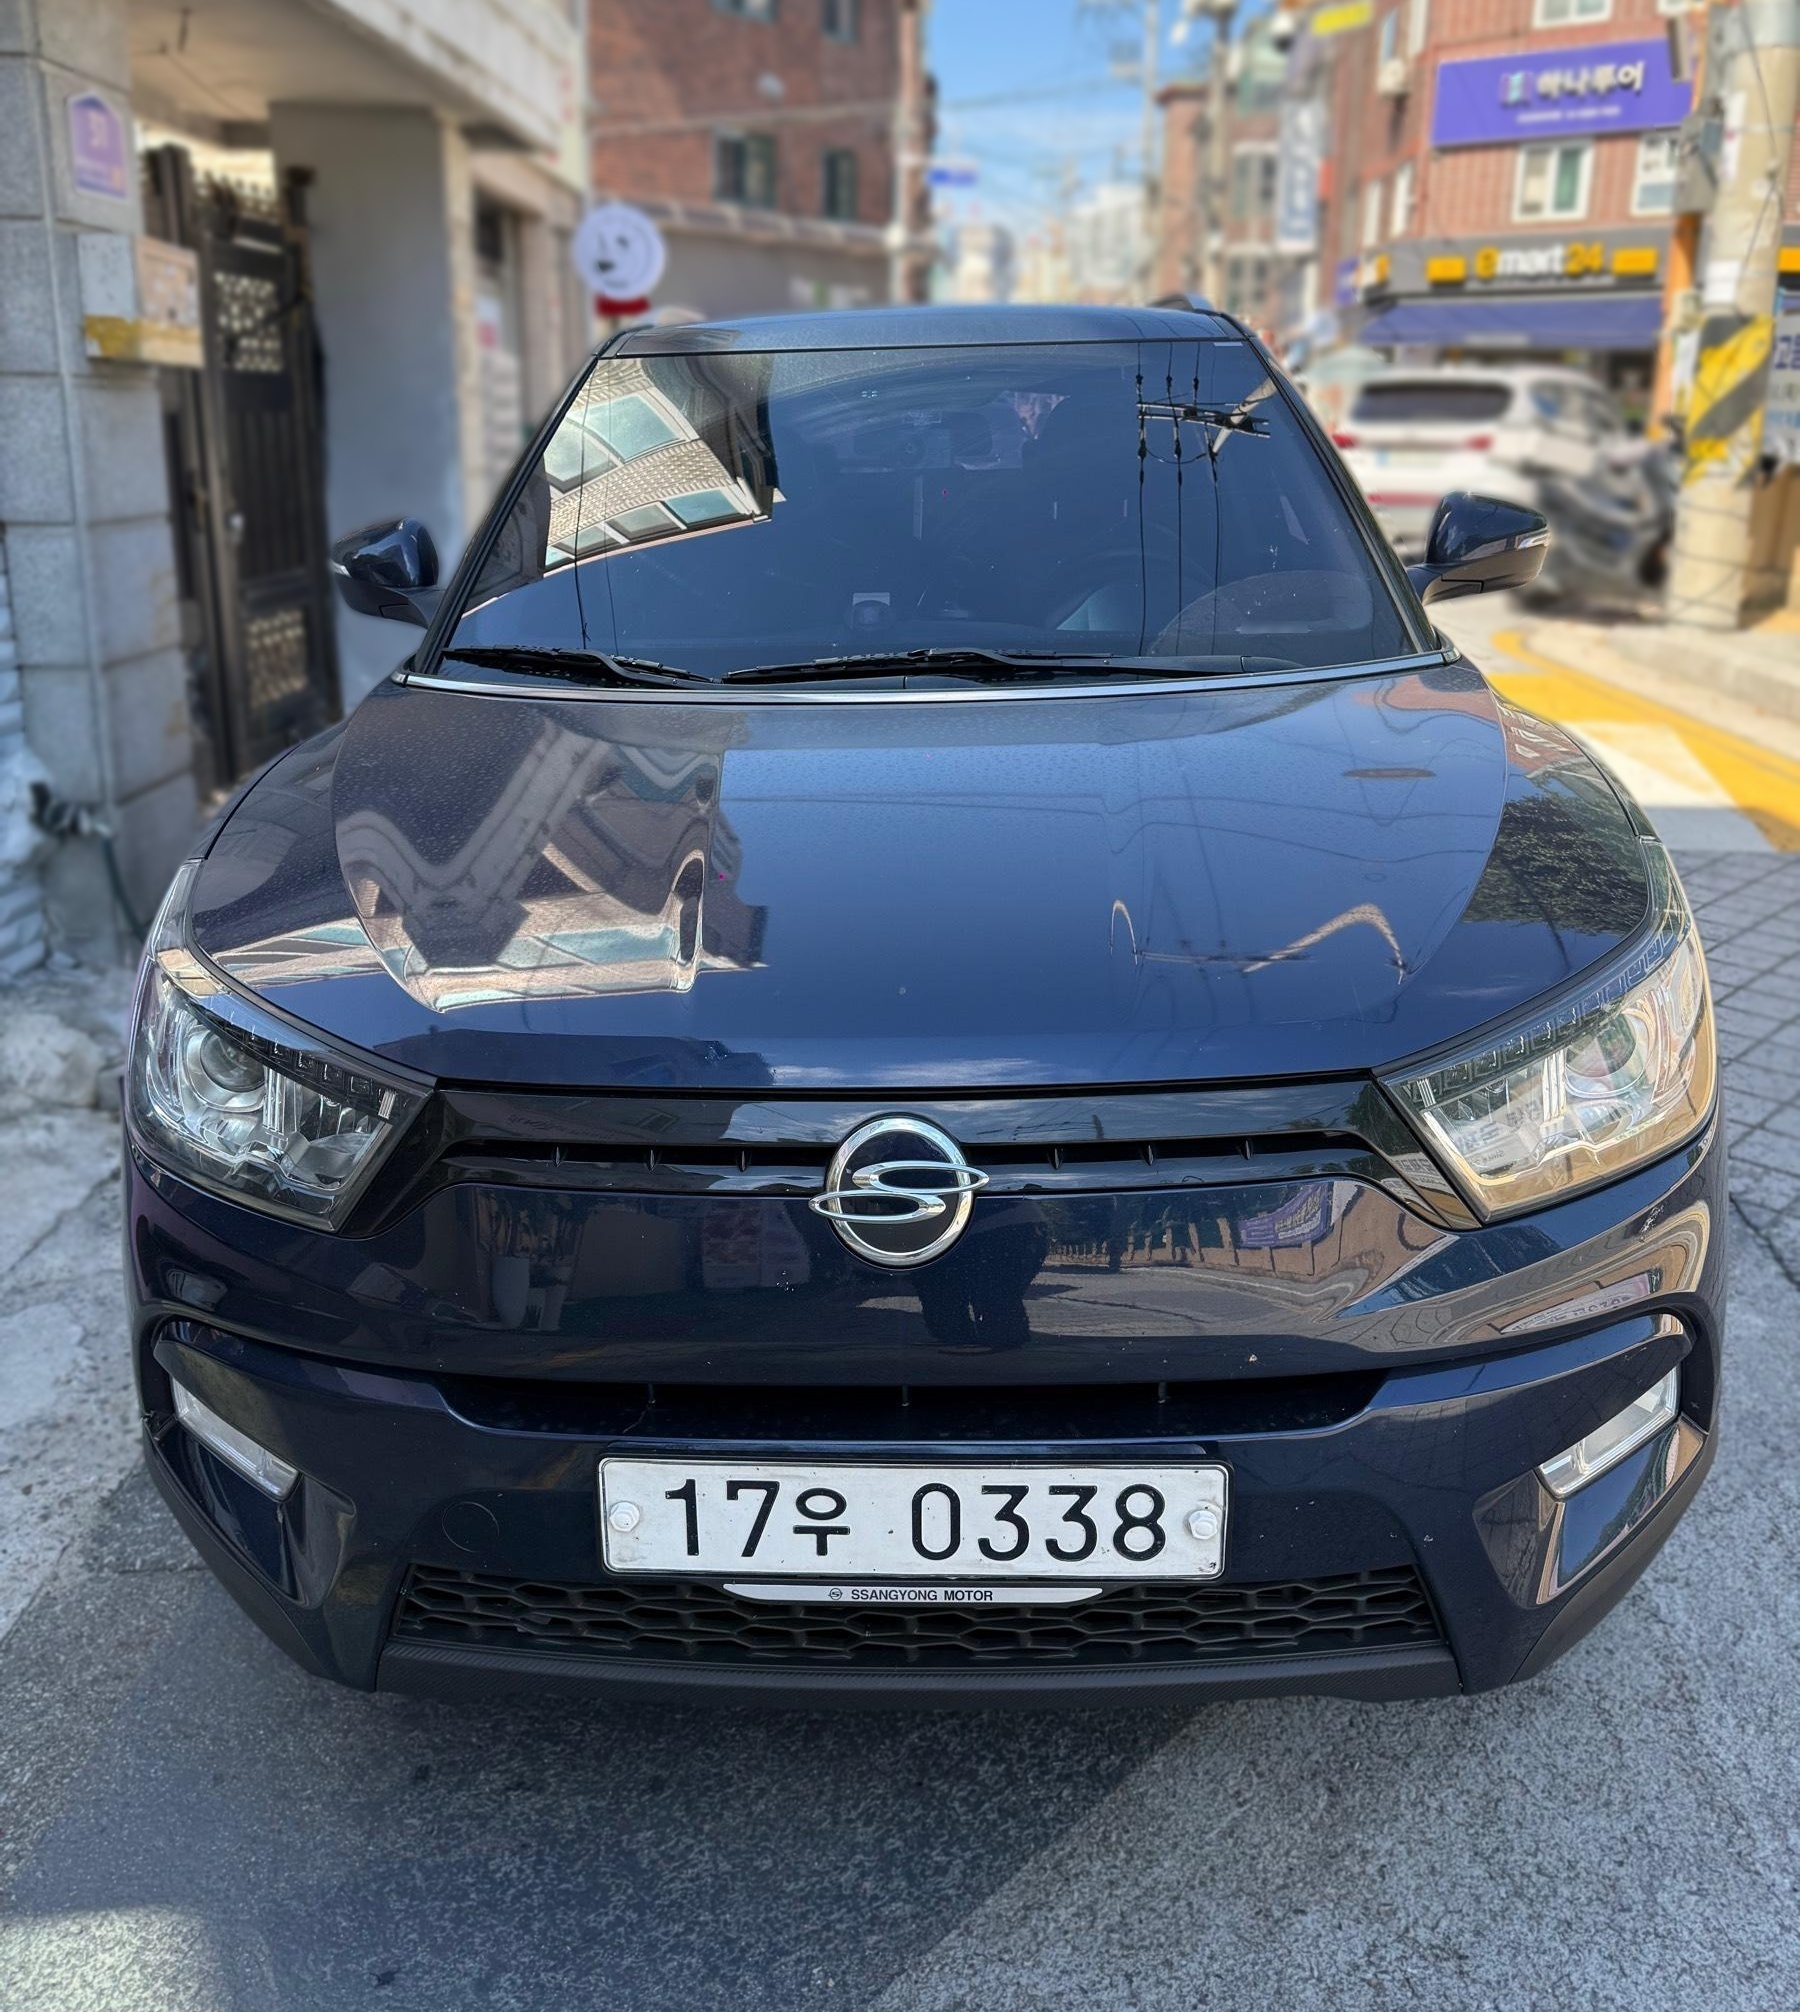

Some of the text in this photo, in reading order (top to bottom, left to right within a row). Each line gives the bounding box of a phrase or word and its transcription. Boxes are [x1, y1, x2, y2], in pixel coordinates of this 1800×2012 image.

[665, 1479, 1166, 1562] 17우 0338
[851, 1589, 993, 1602] SSANGYONG MOTOR
